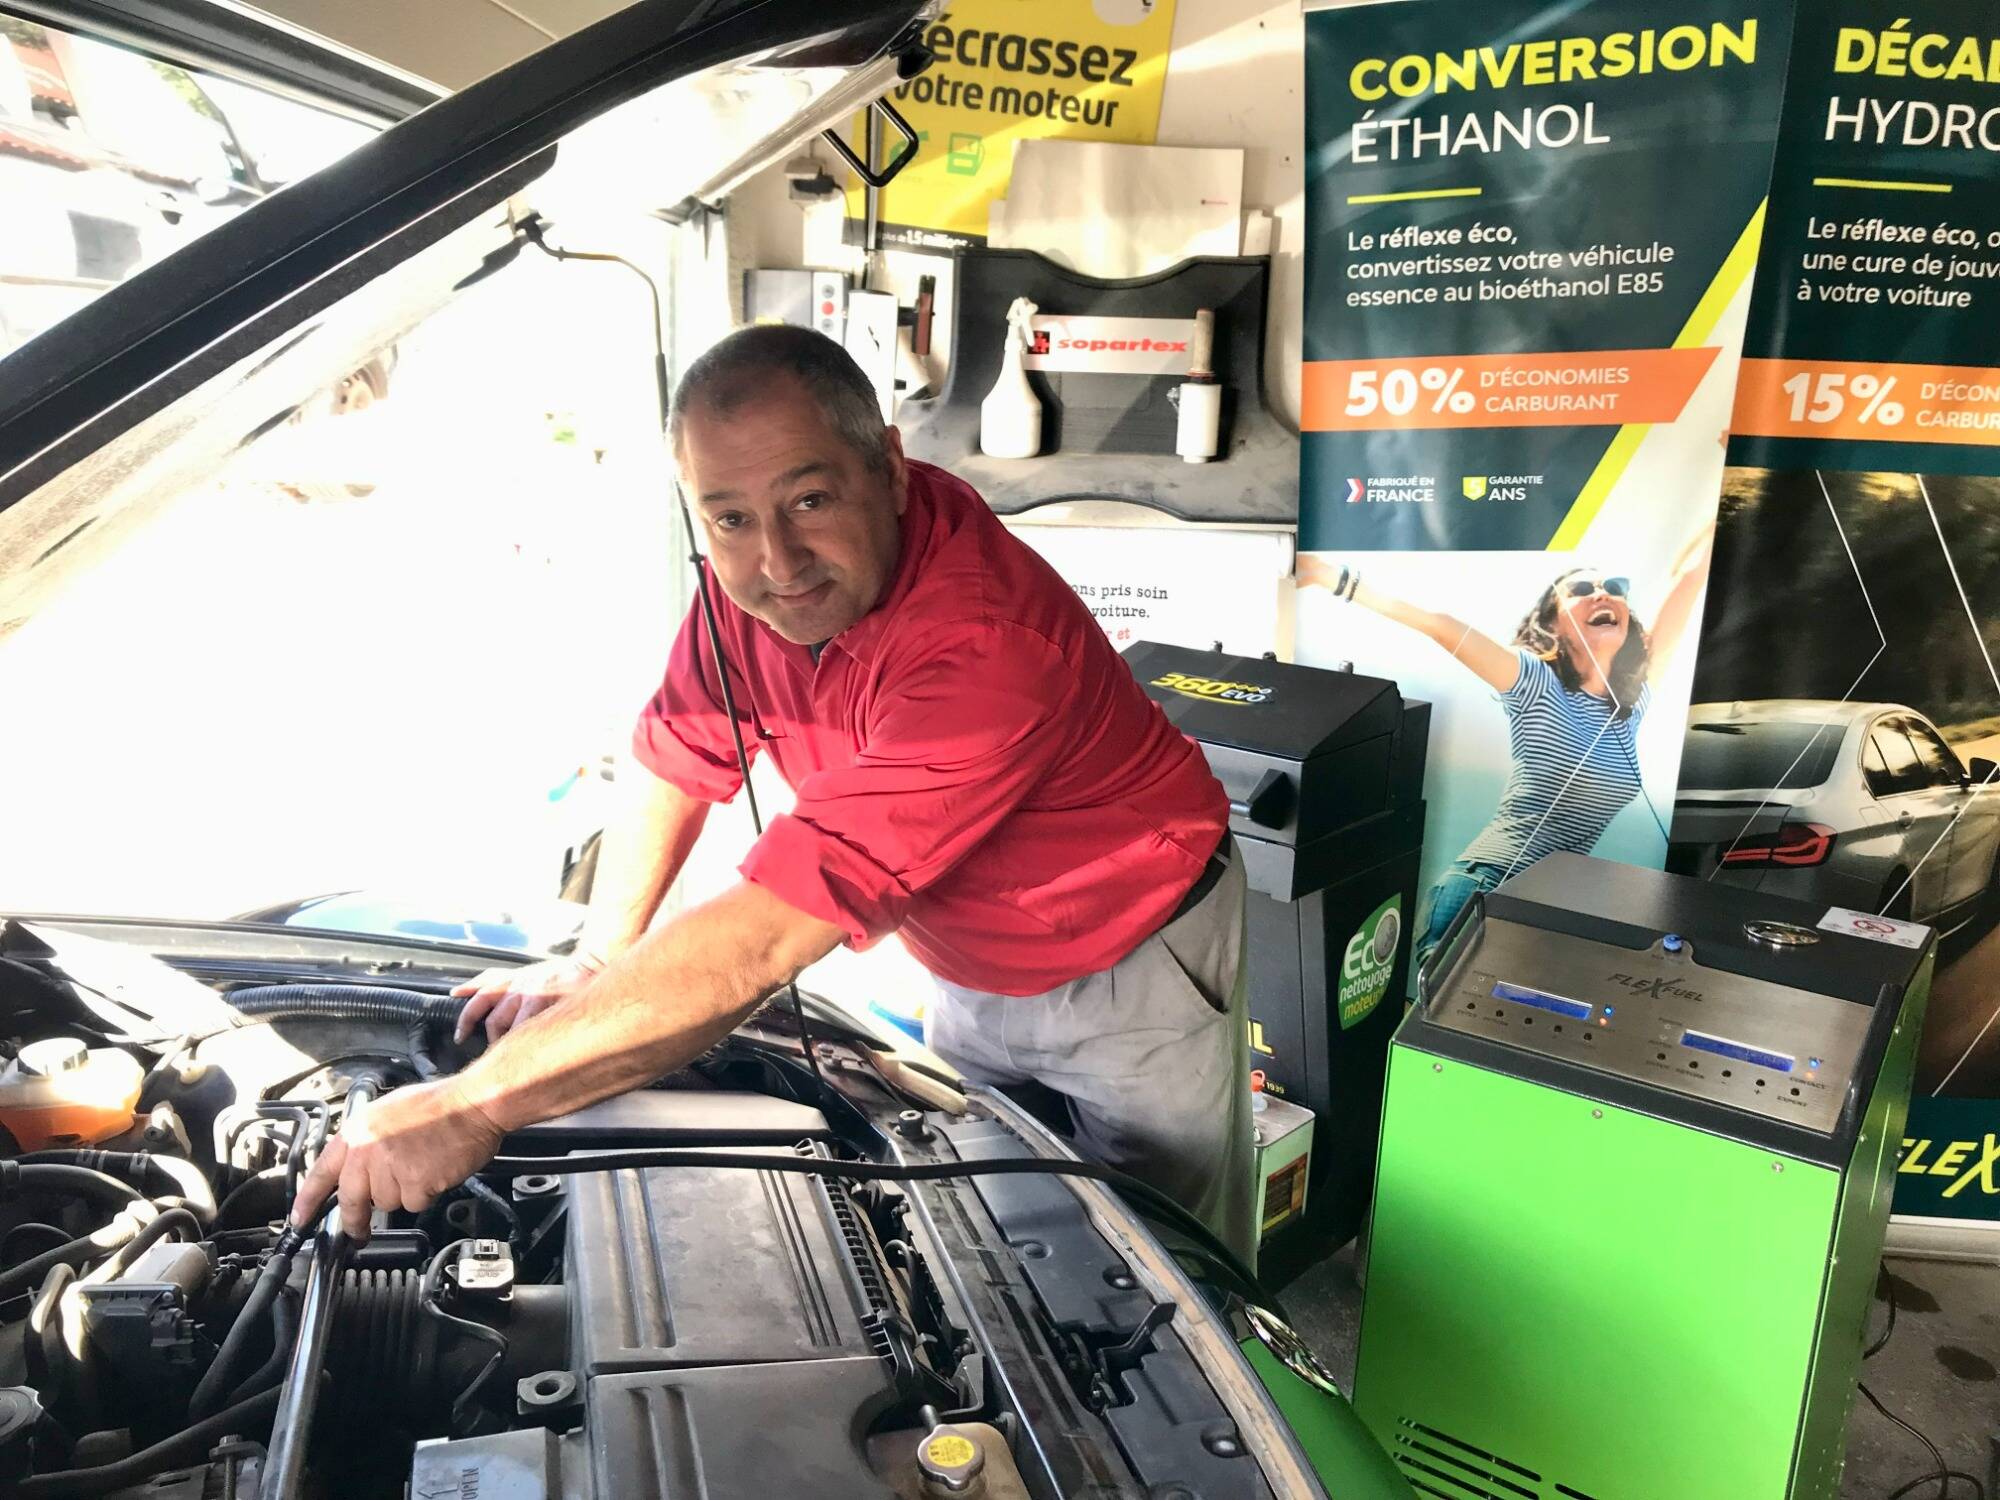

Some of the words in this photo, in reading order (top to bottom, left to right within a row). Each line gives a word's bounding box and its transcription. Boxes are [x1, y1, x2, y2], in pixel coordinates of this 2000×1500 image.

[922, 14, 1137, 87] écrassez
[1349, 18, 1758, 101] CONVERSION
[894, 74, 983, 110] votre
[989, 84, 1119, 127] moteur
[1351, 102, 1611, 164] ÉTHANOL
[1348, 231, 1374, 251] Le
[1379, 225, 1462, 249] réflexe
[1467, 222, 1518, 246] éco,
[1807, 216, 1837, 239] Le
[1841, 218, 1928, 243] réflexe
[1931, 222, 1982, 250] éco,
[1347, 255, 1492, 280] convertissez
[1498, 251, 1563, 272] votre
[1568, 242, 1675, 267] véhicule
[1802, 253, 1848, 271] une
[1851, 254, 1907, 273] cure
[1912, 252, 1944, 275] de
[1944, 255, 2000, 281] jouv
[1346, 284, 1439, 307] essence
[1443, 284, 1472, 301] au
[1479, 273, 1610, 301] bioéthanol
[1617, 271, 1665, 295] E85
[1796, 278, 1813, 301] à
[1818, 283, 1881, 304] votre
[1887, 284, 1972, 308] voiture
[1057, 338, 1188, 352] sopartex
[1480, 366, 1631, 388] D'ÉCONOMIES
[1344, 367, 1476, 417] 50%
[1485, 393, 1620, 414] CARBURANT
[1783, 372, 1905, 426] 15%
[1367, 475, 1418, 487] FABRIQUÉ
[1419, 477, 1435, 486] EN
[1488, 475, 1544, 485] GARANTIE
[1488, 487, 1527, 501] ANS
[1367, 488, 1435, 502] FRANCE
[1072, 584, 1096, 596] ons
[1101, 584, 1131, 599] pris
[1137, 586, 1168, 600] soin
[1092, 604, 1150, 618] voiture.
[1150, 673, 1230, 695] 360
[1340, 964, 1392, 1003] nettoyage
